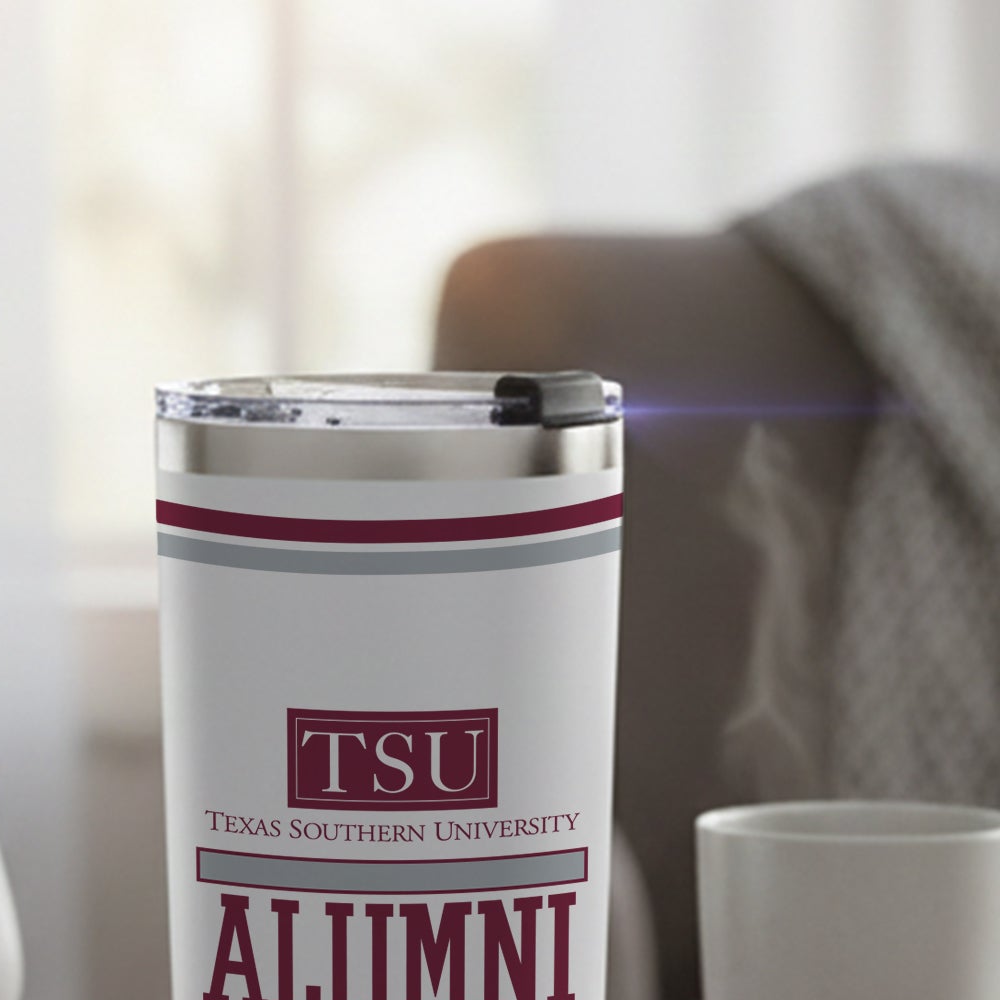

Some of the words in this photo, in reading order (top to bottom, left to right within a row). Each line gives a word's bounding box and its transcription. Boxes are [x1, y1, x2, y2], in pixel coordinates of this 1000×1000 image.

[301, 729, 485, 794] TSU
[204, 810, 281, 837] TEXAS
[289, 819, 425, 842] SOUTHERN
[435, 812, 580, 841] UNIVERSITY
